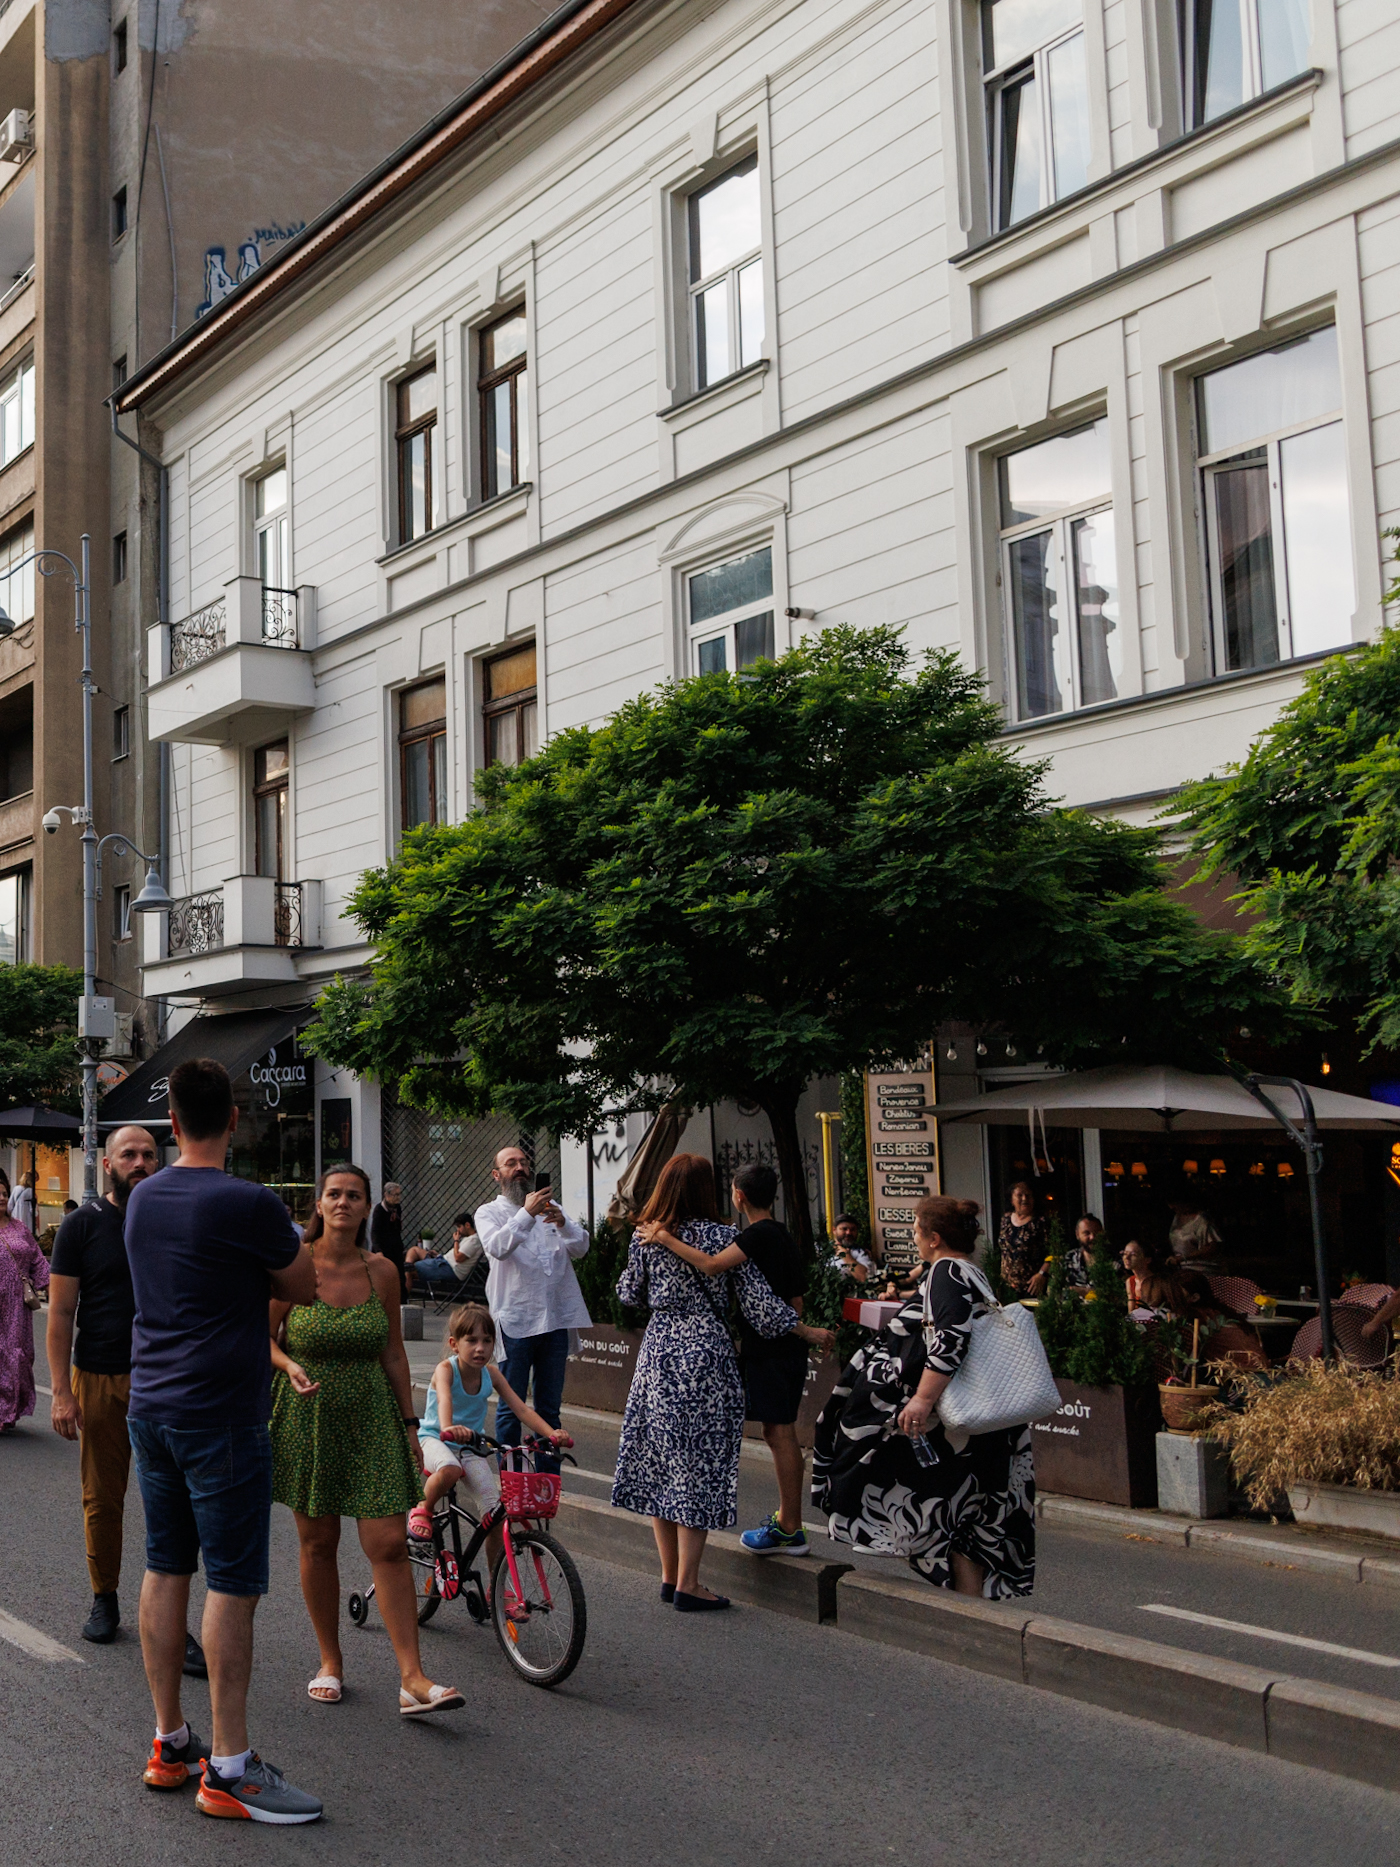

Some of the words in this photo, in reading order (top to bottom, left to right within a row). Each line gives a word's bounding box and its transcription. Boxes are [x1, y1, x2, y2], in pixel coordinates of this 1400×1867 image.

[250, 1062, 306, 1107] Cascara
[881, 1097, 920, 1106] Provence
[881, 1121, 920, 1131] Romanian
[874, 1143, 894, 1155] LES
[884, 1228, 909, 1239] Sweet
[596, 1341, 607, 1351] DU
[609, 1340, 630, 1354] GOÛT
[1035, 1423, 1051, 1432] and
[1052, 1426, 1080, 1436] snacks
